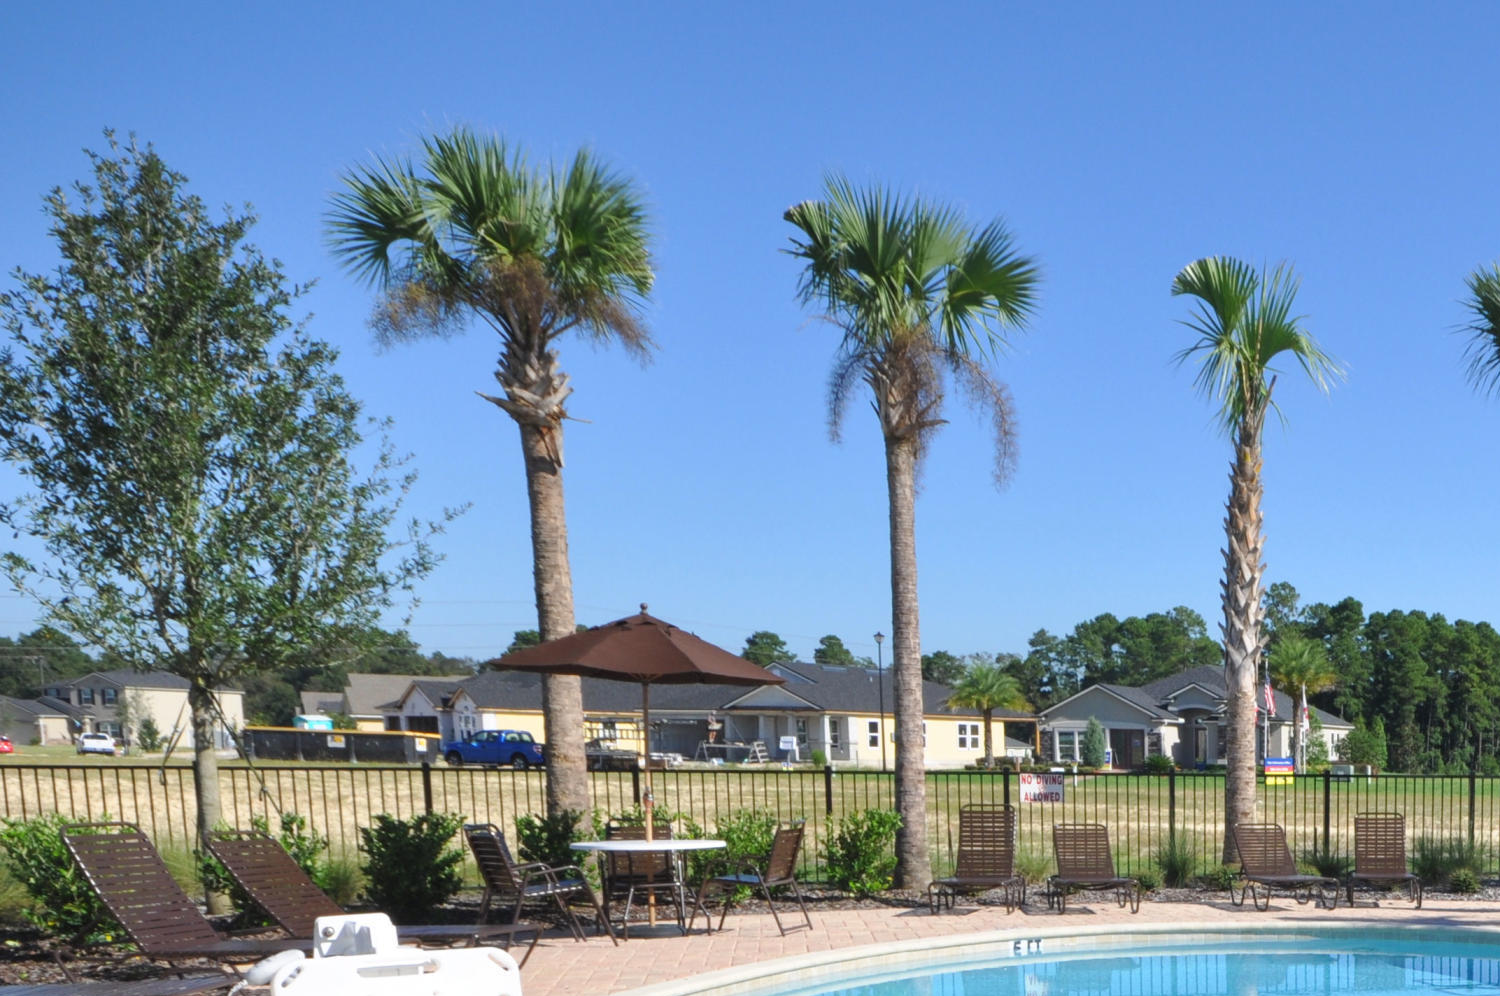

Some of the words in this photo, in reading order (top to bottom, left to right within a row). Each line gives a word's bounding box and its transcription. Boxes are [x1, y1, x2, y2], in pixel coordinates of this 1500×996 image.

[1021, 774, 1032, 785] NO
[1036, 774, 1062, 785] DIVING
[1024, 791, 1061, 802] ALLOWED
